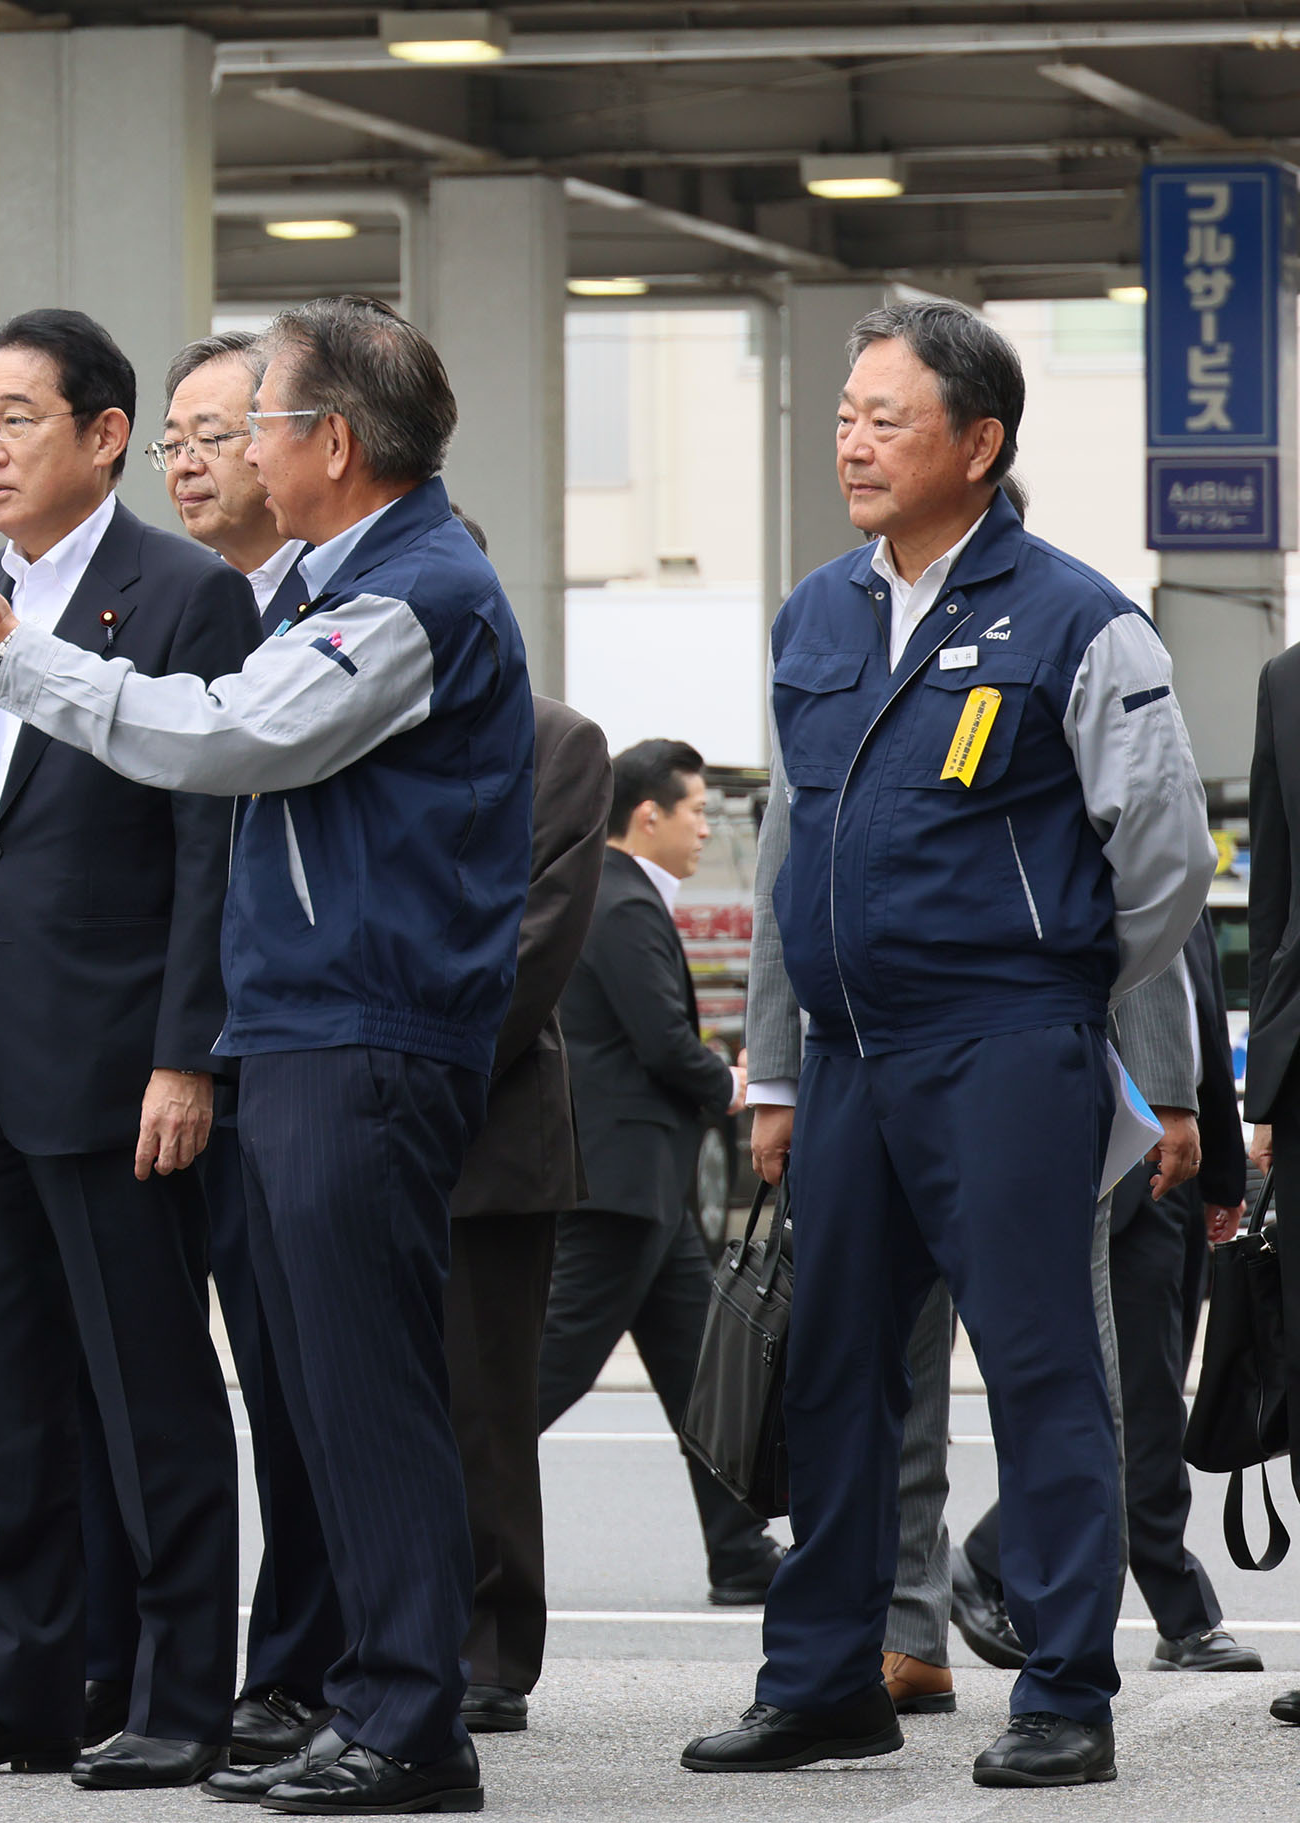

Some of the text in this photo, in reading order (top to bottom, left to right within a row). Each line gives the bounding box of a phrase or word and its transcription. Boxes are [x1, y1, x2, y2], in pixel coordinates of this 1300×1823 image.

[1184, 183, 1234, 432] フルサービス
[1168, 480, 1255, 503] AdBlue
